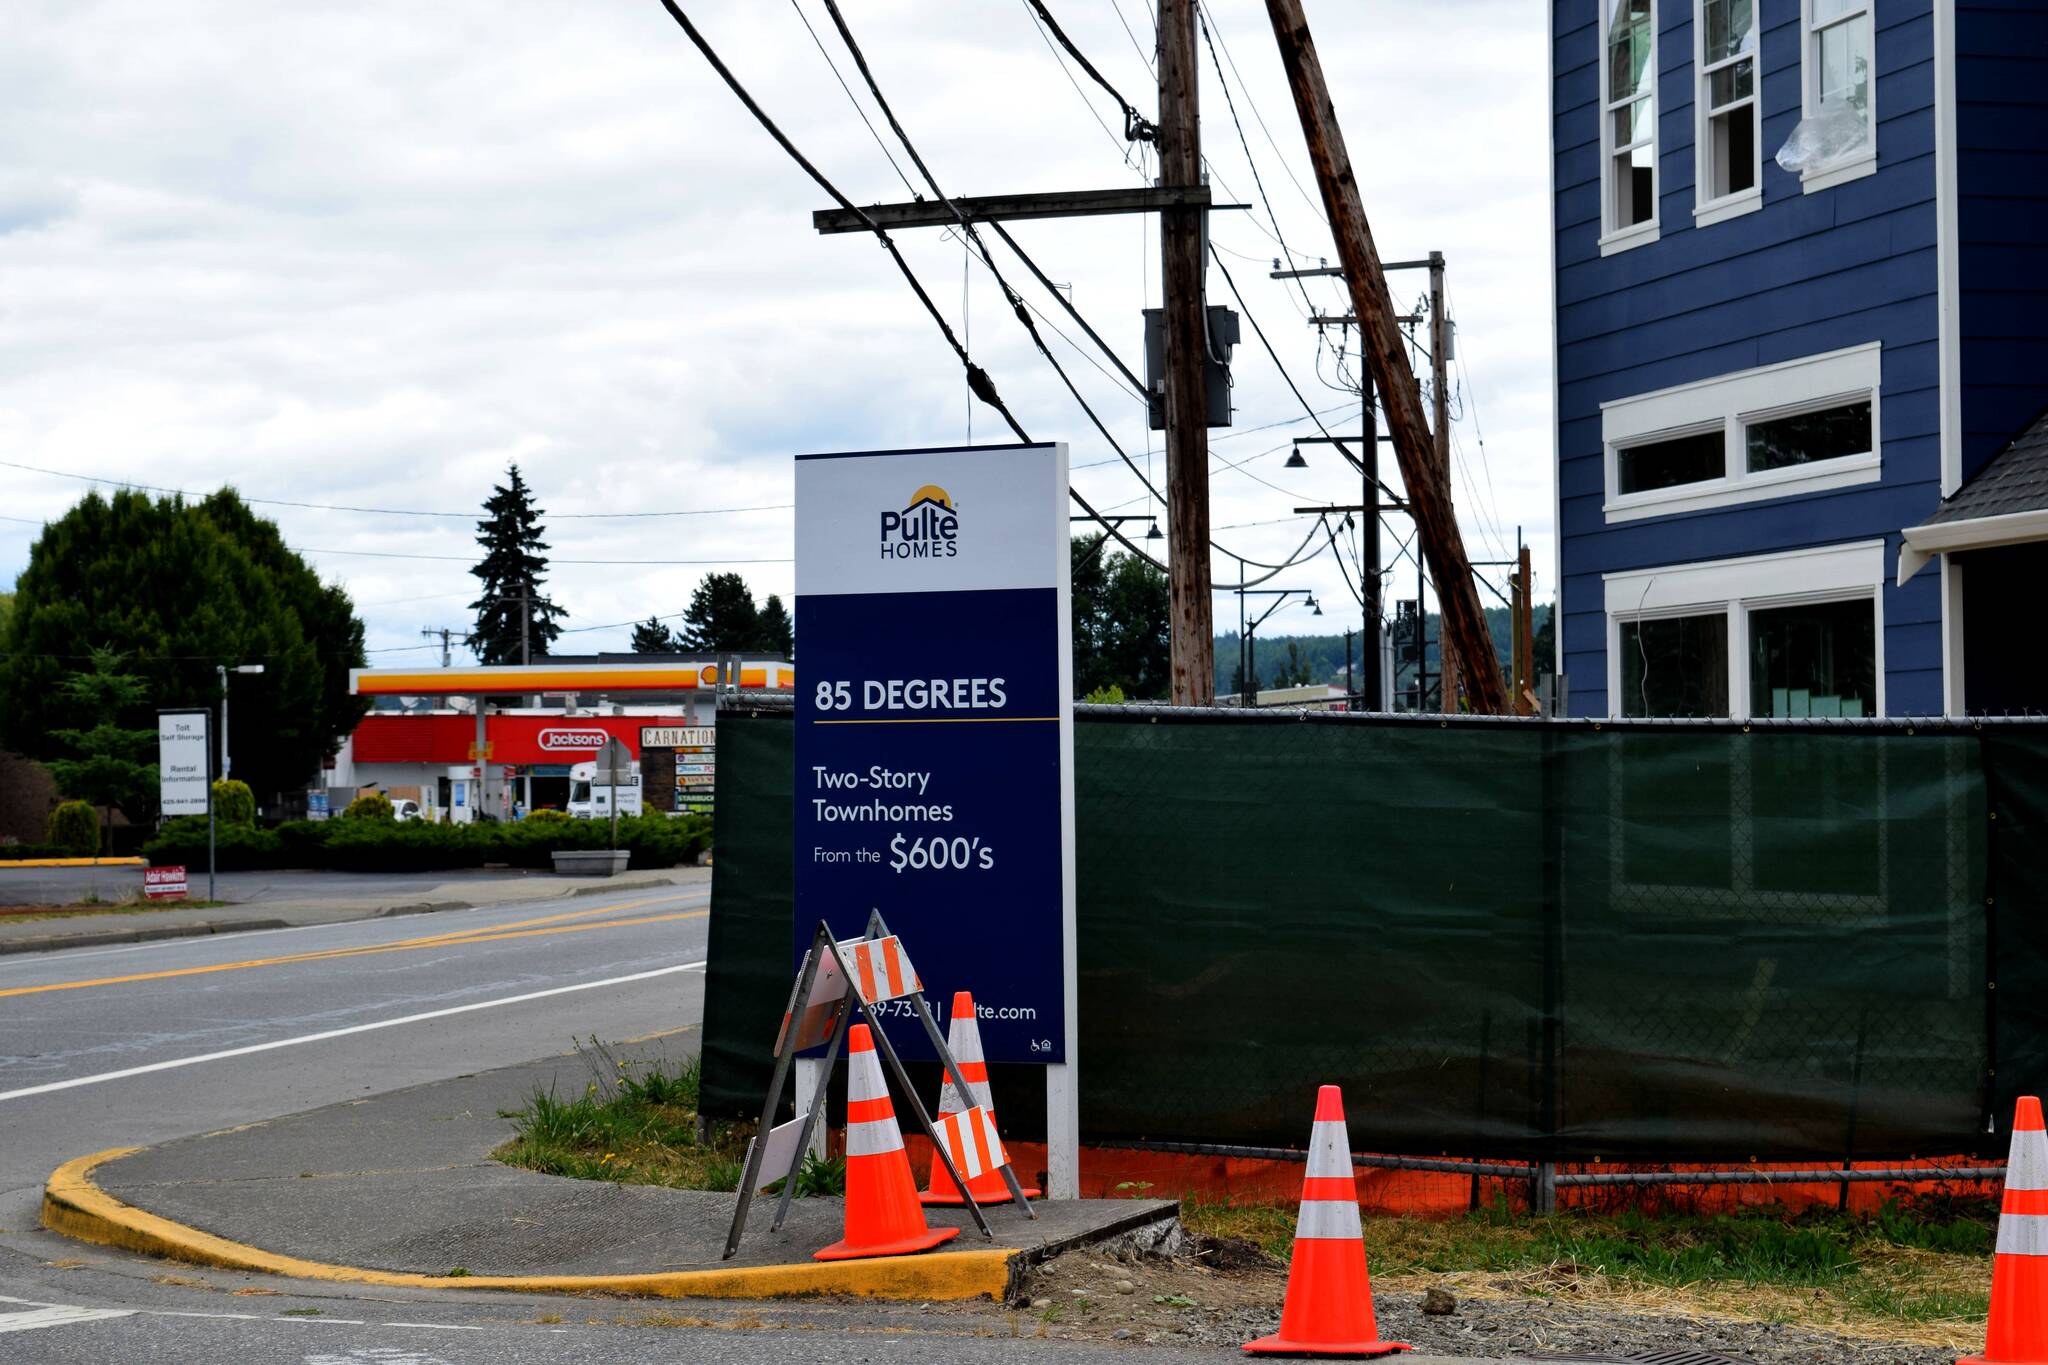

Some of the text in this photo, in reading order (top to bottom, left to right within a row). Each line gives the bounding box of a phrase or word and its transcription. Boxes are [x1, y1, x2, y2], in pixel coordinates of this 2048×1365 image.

[880, 506, 959, 542] Pulte
[880, 541, 958, 559] HOMES
[814, 678, 1007, 711] 85 DEGREES
[176, 734, 205, 742] Storage
[812, 765, 931, 795] Two-Story
[812, 798, 954, 822] Townhomes
[813, 833, 994, 873] From the $600's
